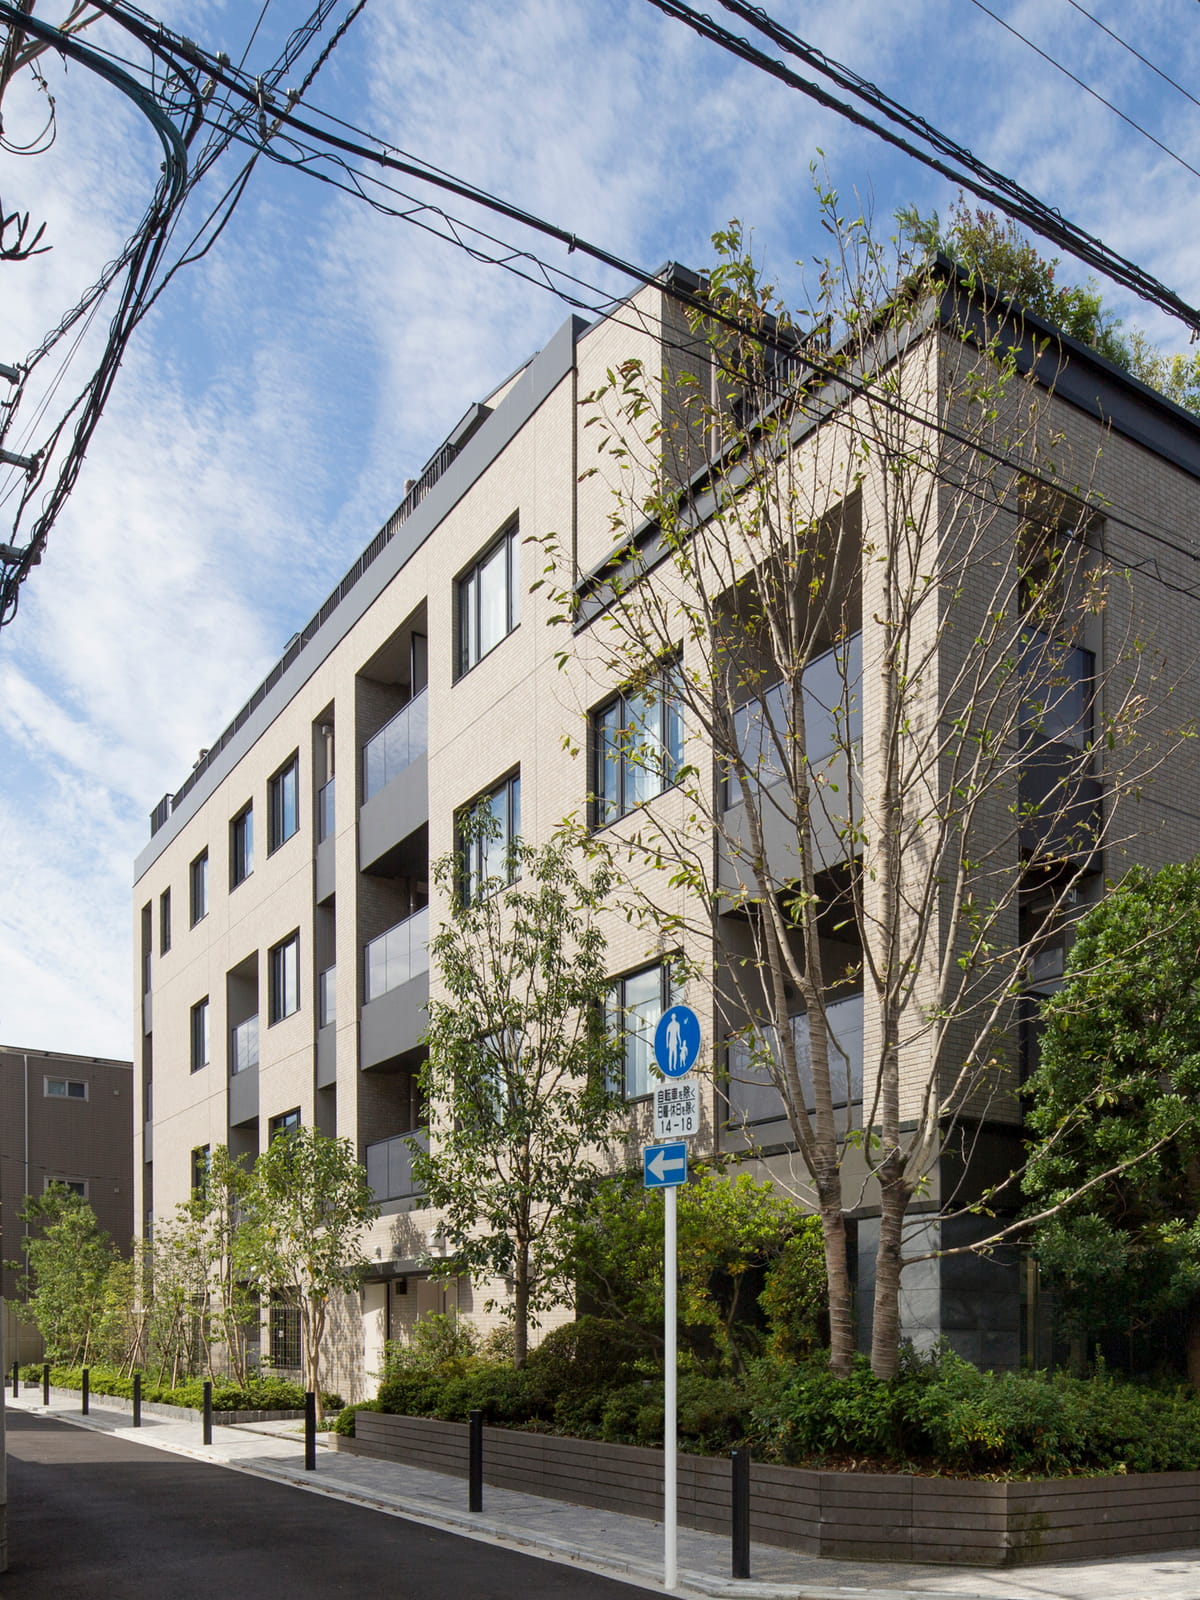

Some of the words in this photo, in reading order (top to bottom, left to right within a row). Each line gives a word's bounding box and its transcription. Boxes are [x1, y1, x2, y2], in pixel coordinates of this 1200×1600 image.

[658, 1086, 695, 1103] 自転車を除く
[661, 1117, 692, 1134] 14-18
